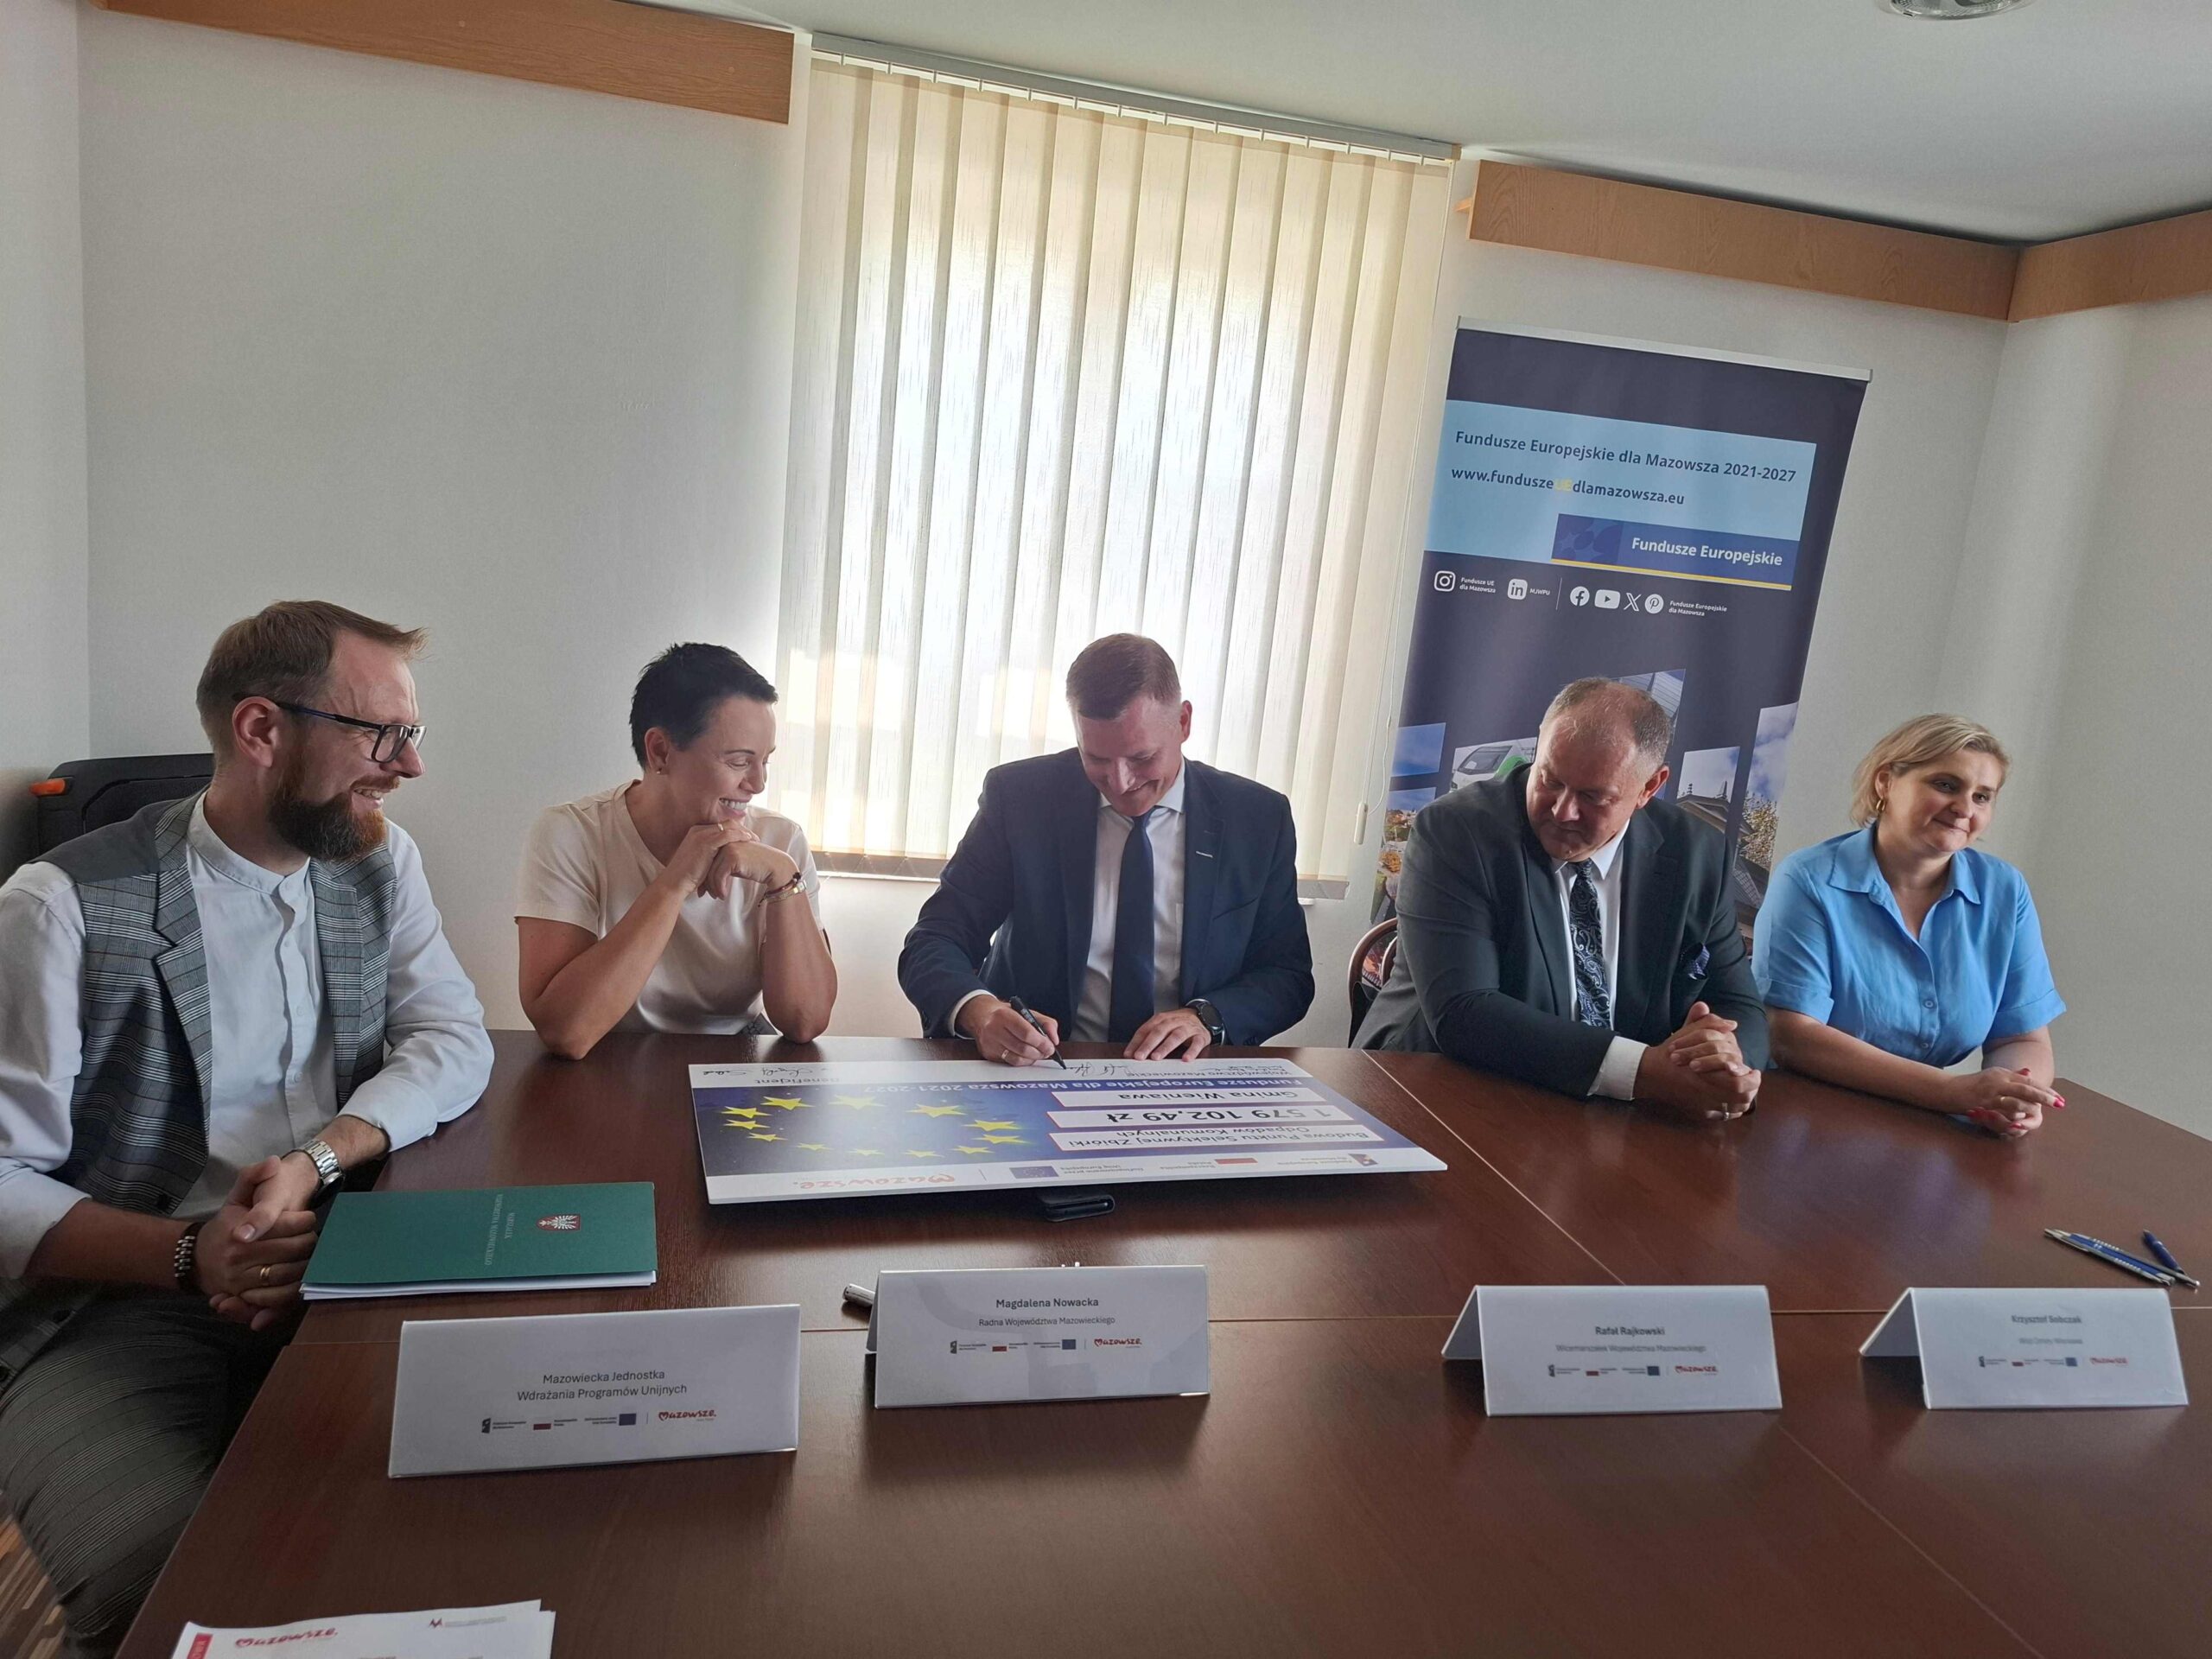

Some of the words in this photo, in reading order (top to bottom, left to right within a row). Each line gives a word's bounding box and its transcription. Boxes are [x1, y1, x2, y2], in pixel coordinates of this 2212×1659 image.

[1455, 430, 1527, 451] Fundusze
[1530, 439, 1615, 464] Europejskie
[1618, 450, 1641, 464] dla
[1646, 454, 1719, 474] Mazowsza
[1723, 461, 1797, 484] 2021-2027
[1631, 537, 1698, 558] Fundusze
[1700, 544, 1783, 569] Europejskie
[1460, 576, 1485, 586] Fundusze
[1529, 588, 1550, 596] MJWPU
[1669, 600, 1694, 609] Fundusze
[1695, 603, 1728, 613] Europejskie
[967, 1082, 1068, 1090] Mazowsza
[1103, 1079, 1217, 1088] Europejskie
[1117, 1092, 1225, 1101] Wieniawa
[1106, 1112, 1134, 1123] zł
[1141, 1109, 1243, 1122] 102,49
[1250, 1109, 1306, 1118] 579
[1116, 1128, 1228, 1138] Komunalnych
[1232, 1126, 1309, 1135] Odpadów
[1302, 1131, 1368, 1140] Budowa
[1136, 1135, 1237, 1146] Selektywnej
[1241, 1134, 1299, 1142] Punktu
[1069, 1139, 1132, 1148] Zbiórki
[995, 1298, 1051, 1310] Magdalena
[1053, 1298, 1099, 1307] Nowacka
[978, 1318, 1004, 1326] Radna
[1006, 1316, 1058, 1328] Województwa
[1059, 1316, 1116, 1326] Mazowieckiego
[1595, 1326, 1619, 1335] Rafał
[1620, 1326, 1665, 1338] Rajkowski
[543, 1372, 610, 1384] Mazowiecka
[611, 1370, 665, 1382] Jednostka
[518, 1389, 575, 1402] Wdrażania
[578, 1386, 639, 1400] Programów
[641, 1383, 687, 1397] Unijnych
